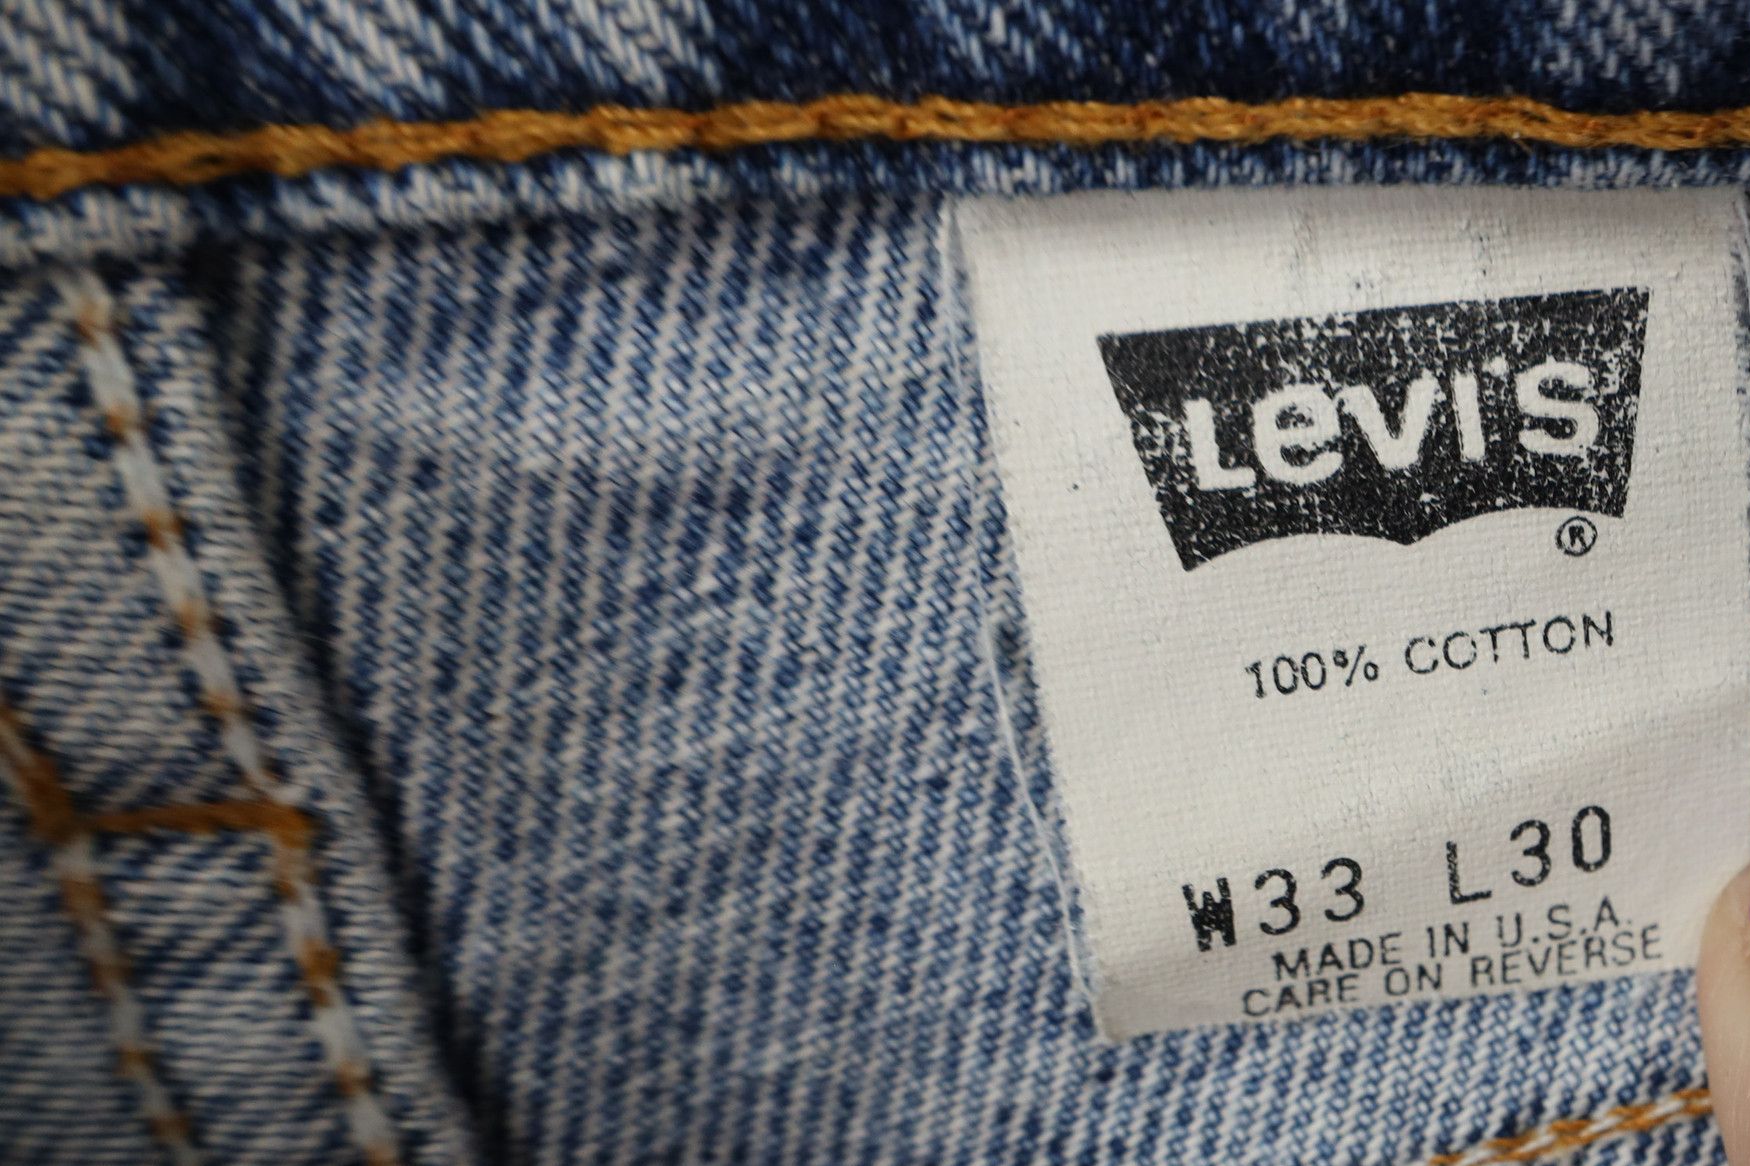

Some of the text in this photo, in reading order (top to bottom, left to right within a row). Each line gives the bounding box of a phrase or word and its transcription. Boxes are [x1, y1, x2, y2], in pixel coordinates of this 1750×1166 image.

[1245, 610, 1614, 700] 100% COTTON
[1182, 805, 1612, 952] W33 L30
[1242, 923, 1662, 1017] CARE ON REVERSE
[1271, 896, 1633, 981] MADE IN U.S.A.
